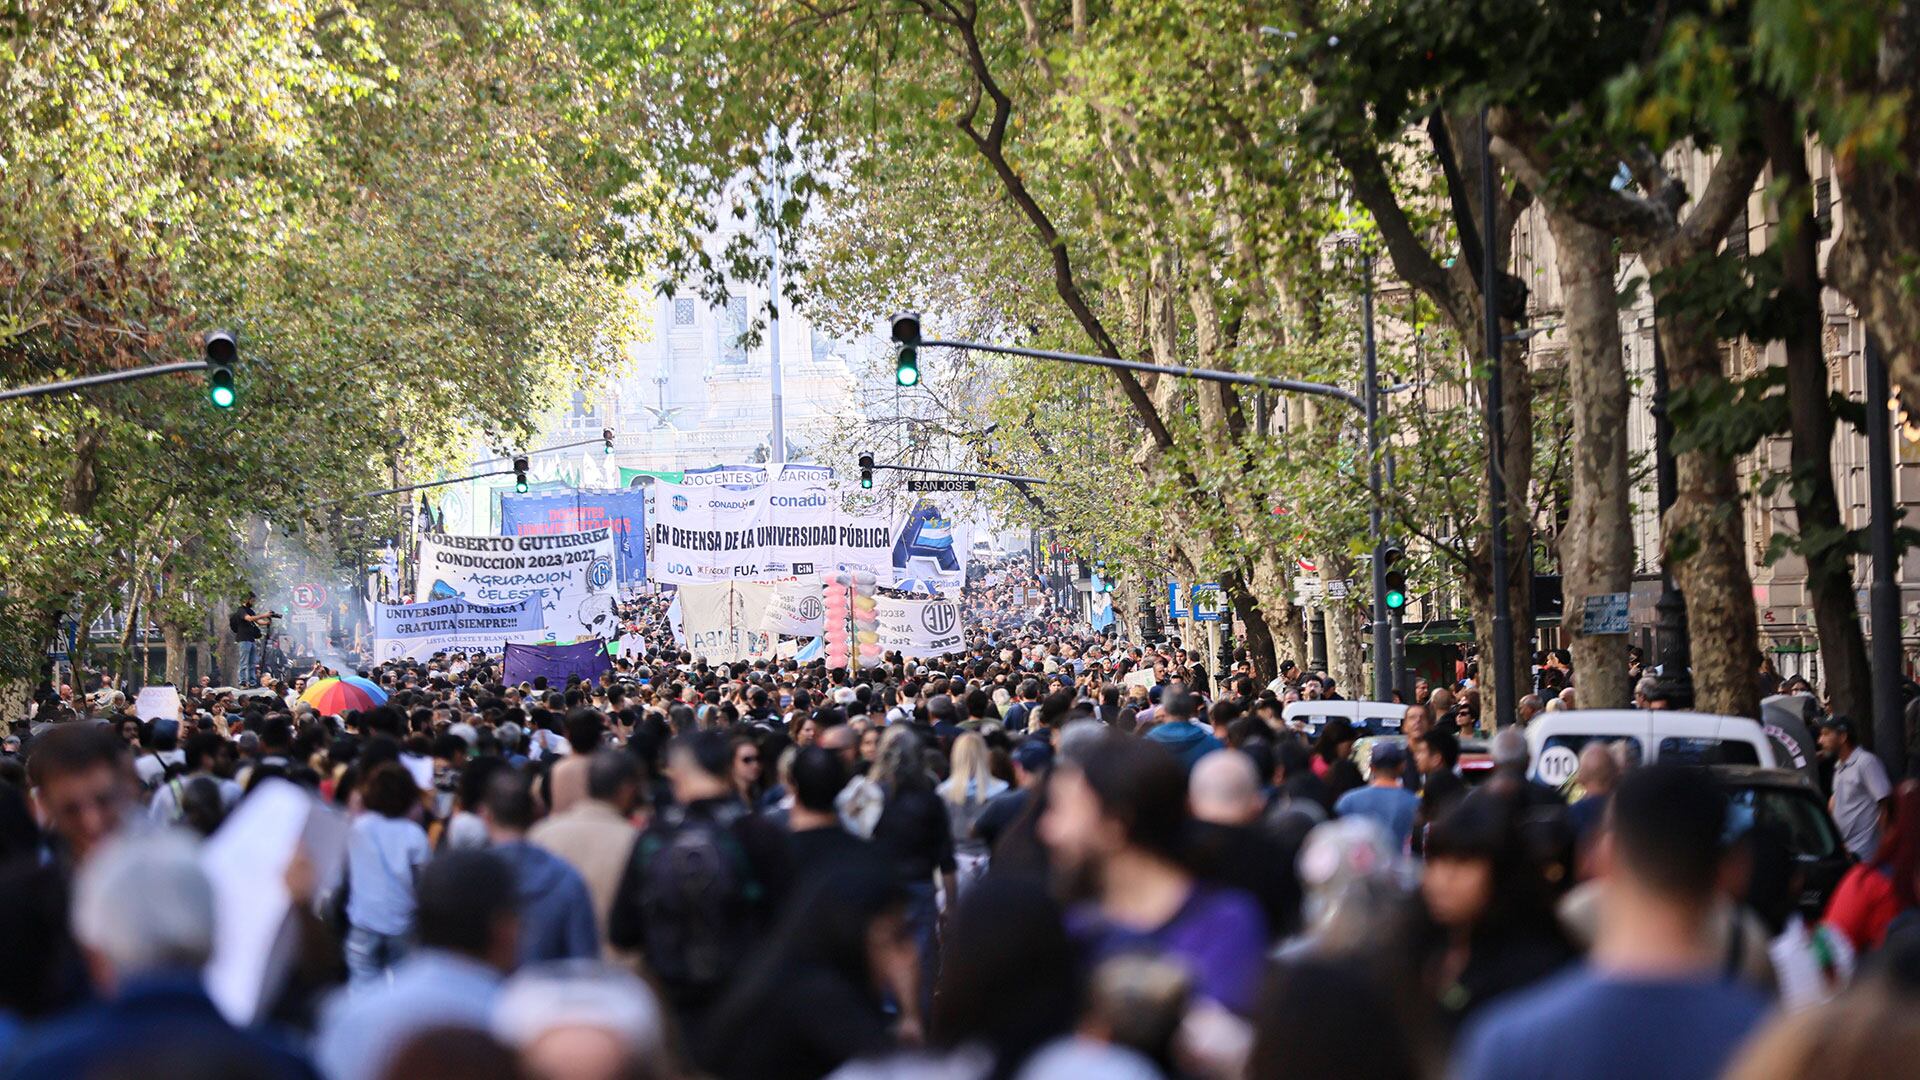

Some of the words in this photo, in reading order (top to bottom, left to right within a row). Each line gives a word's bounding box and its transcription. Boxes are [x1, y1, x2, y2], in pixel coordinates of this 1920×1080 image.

[914, 481, 938, 491] SAN
[940, 481, 969, 491] JOSE
[770, 493, 826, 507] conadu
[423, 533, 515, 551] NORBERTO
[518, 527, 610, 550] GUTIERREZ
[656, 523, 670, 545] EN
[672, 527, 721, 551] DEFENSA
[725, 532, 739, 551] DE
[740, 529, 755, 549] LA
[757, 525, 836, 547] UNIVERSIDAD
[839, 523, 890, 548] PÚBLICA
[436, 552, 526, 569] CONDUCCION
[528, 550, 596, 569] 2023/2027
[667, 562, 693, 576] UDA
[734, 564, 759, 576] FUA
[468, 571, 572, 586] AGRUPACION
[553, 587, 564, 601] Y
[386, 603, 464, 619] UNIVERSIDAD
[396, 621, 456, 634] GRATUITA
[457, 618, 518, 629] SIEMPRE!!!
